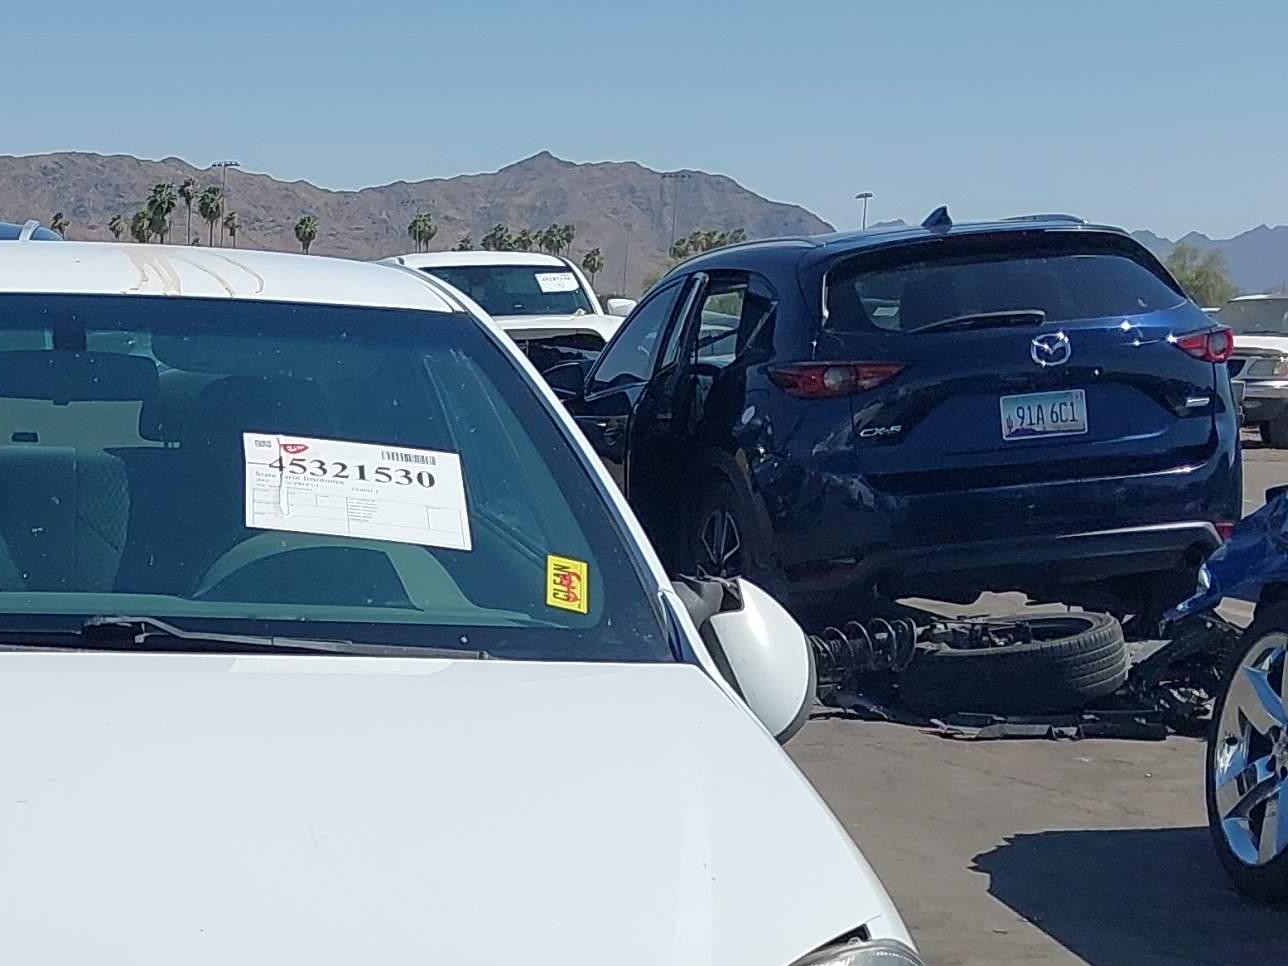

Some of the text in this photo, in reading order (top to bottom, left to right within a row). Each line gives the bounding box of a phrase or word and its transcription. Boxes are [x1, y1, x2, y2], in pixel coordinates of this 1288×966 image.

[1017, 402, 1079, 426] 91A 6C1
[269, 456, 435, 488] 45321530
